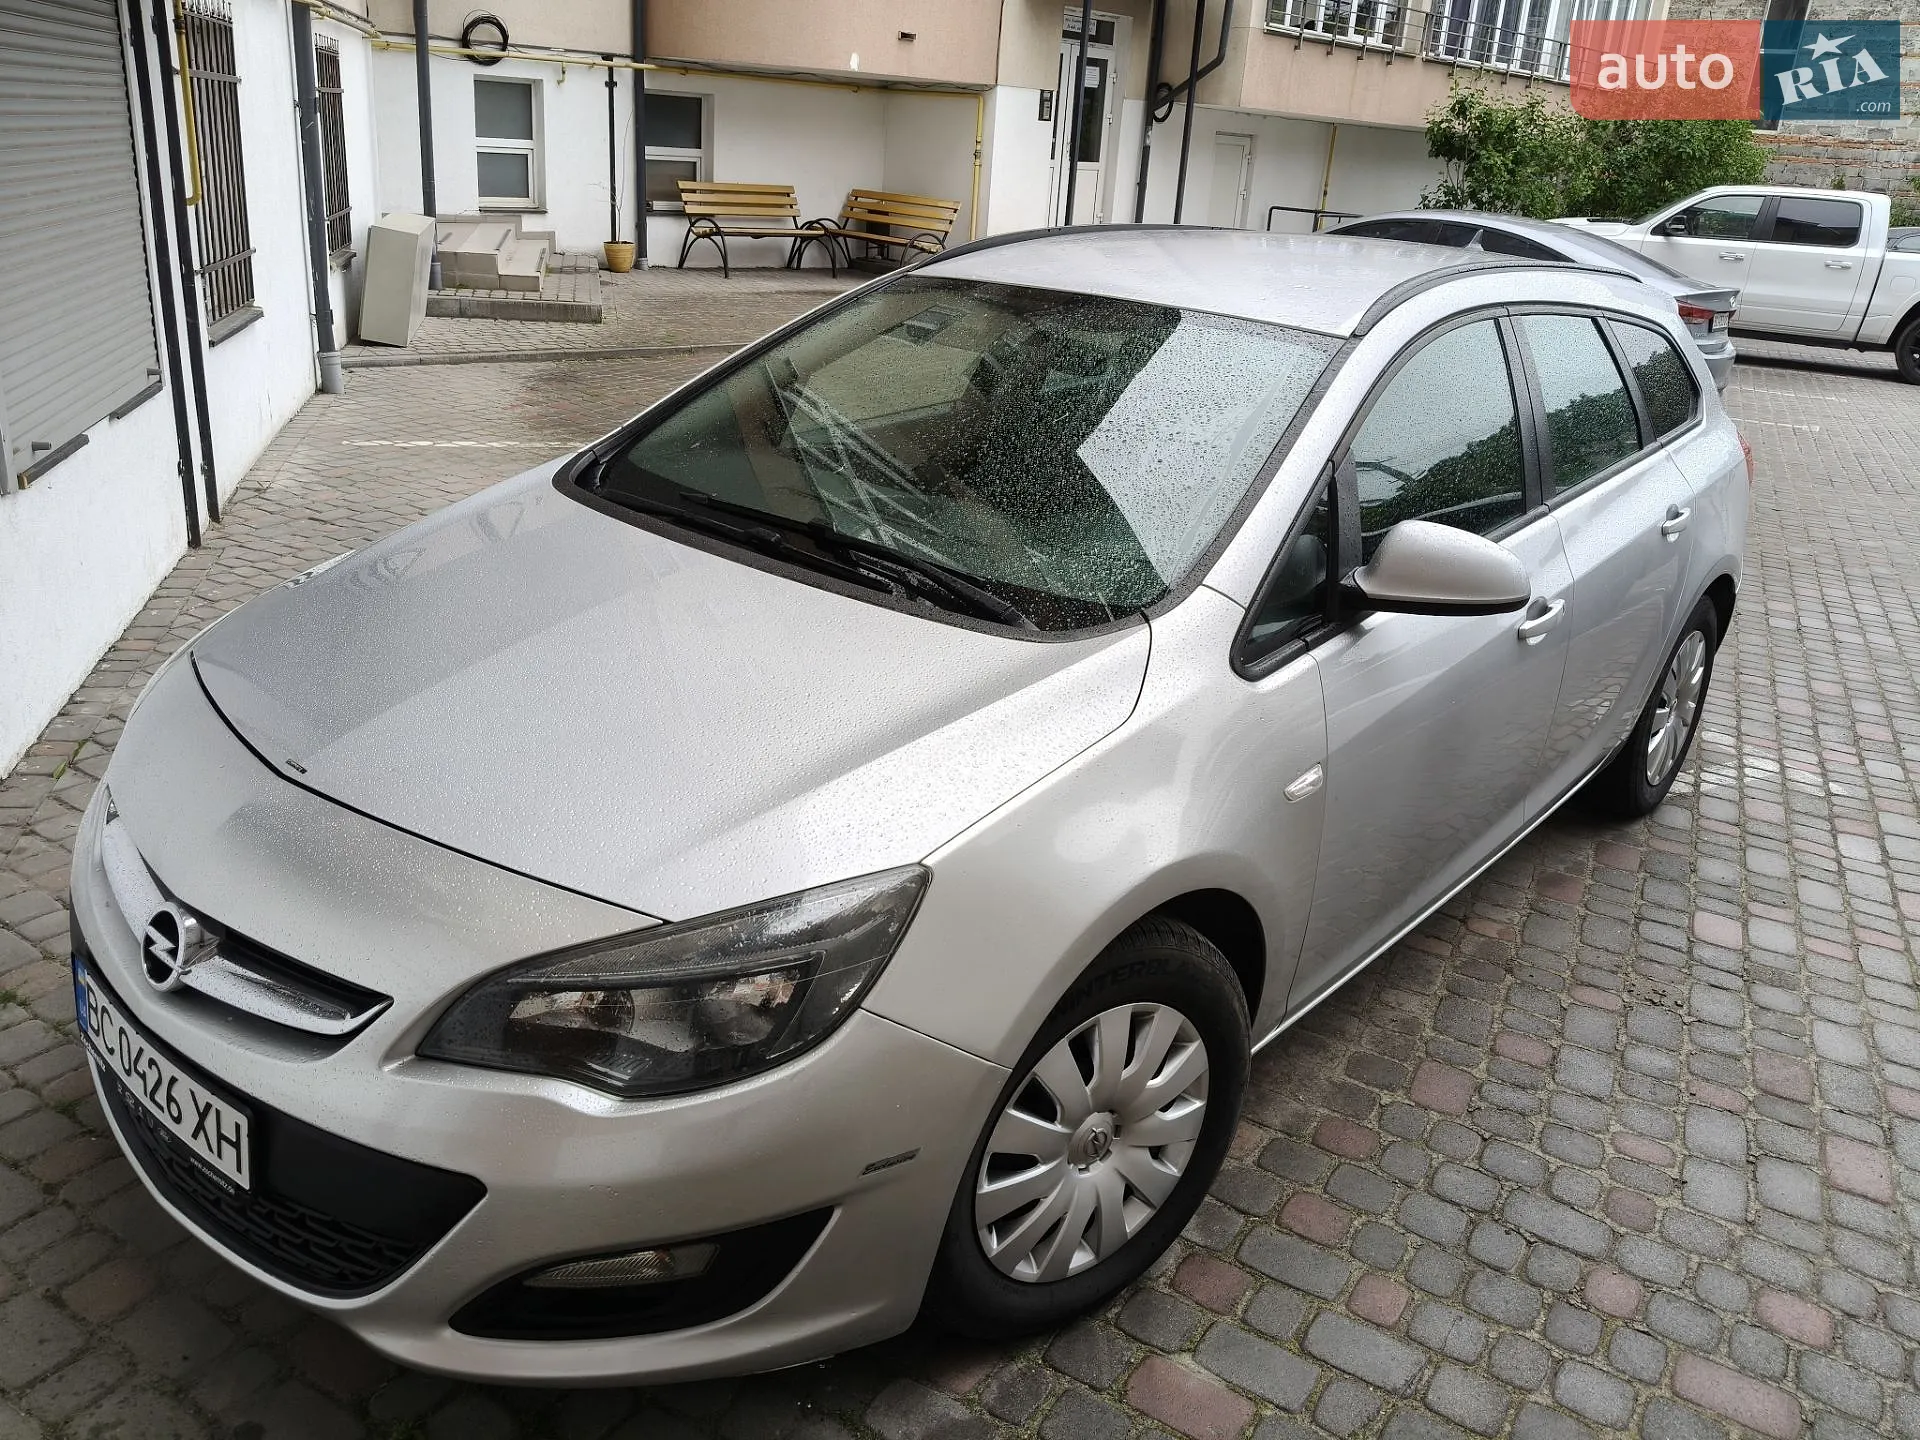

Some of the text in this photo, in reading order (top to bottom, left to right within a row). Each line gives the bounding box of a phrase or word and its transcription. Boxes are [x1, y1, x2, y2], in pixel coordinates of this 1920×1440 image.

[85, 982, 116, 1057] BC
[118, 1026, 183, 1125] 0426
[189, 1088, 243, 1175] XH
